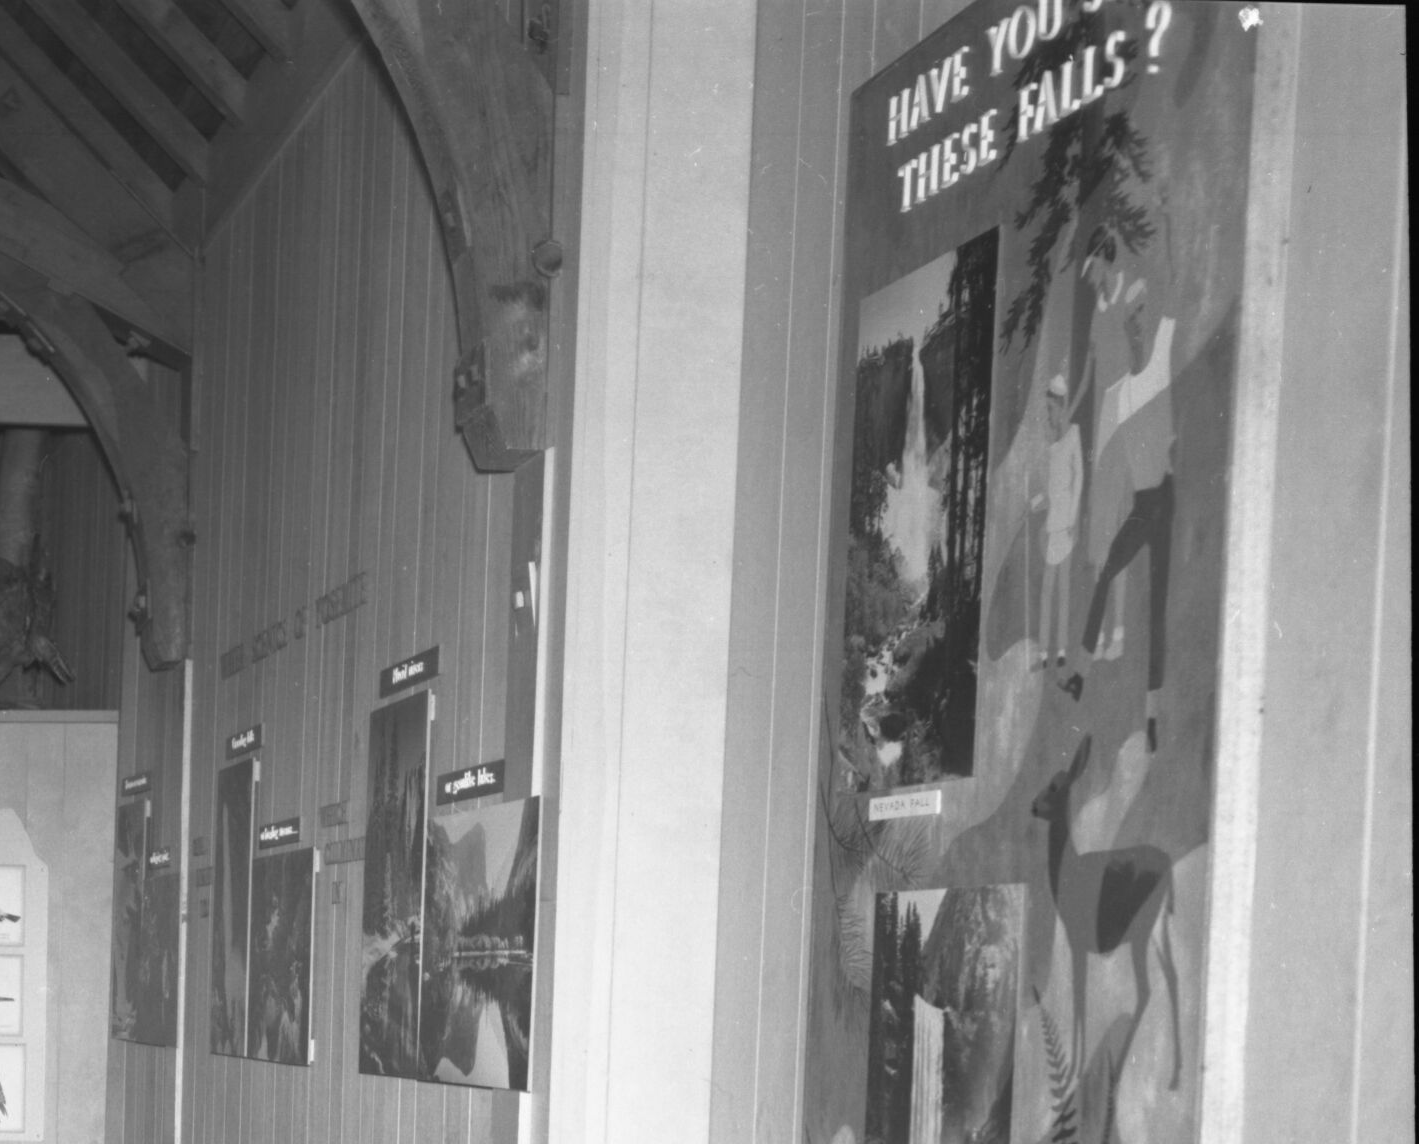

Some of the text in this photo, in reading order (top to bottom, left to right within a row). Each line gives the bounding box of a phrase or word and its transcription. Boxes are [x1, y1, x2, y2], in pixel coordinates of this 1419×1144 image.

[886, 0, 1063, 147] HAVE YOU
[897, 109, 998, 213] THESE
[1016, 30, 1126, 144] FALLS
[874, 798, 930, 812] NEVADA FALL
